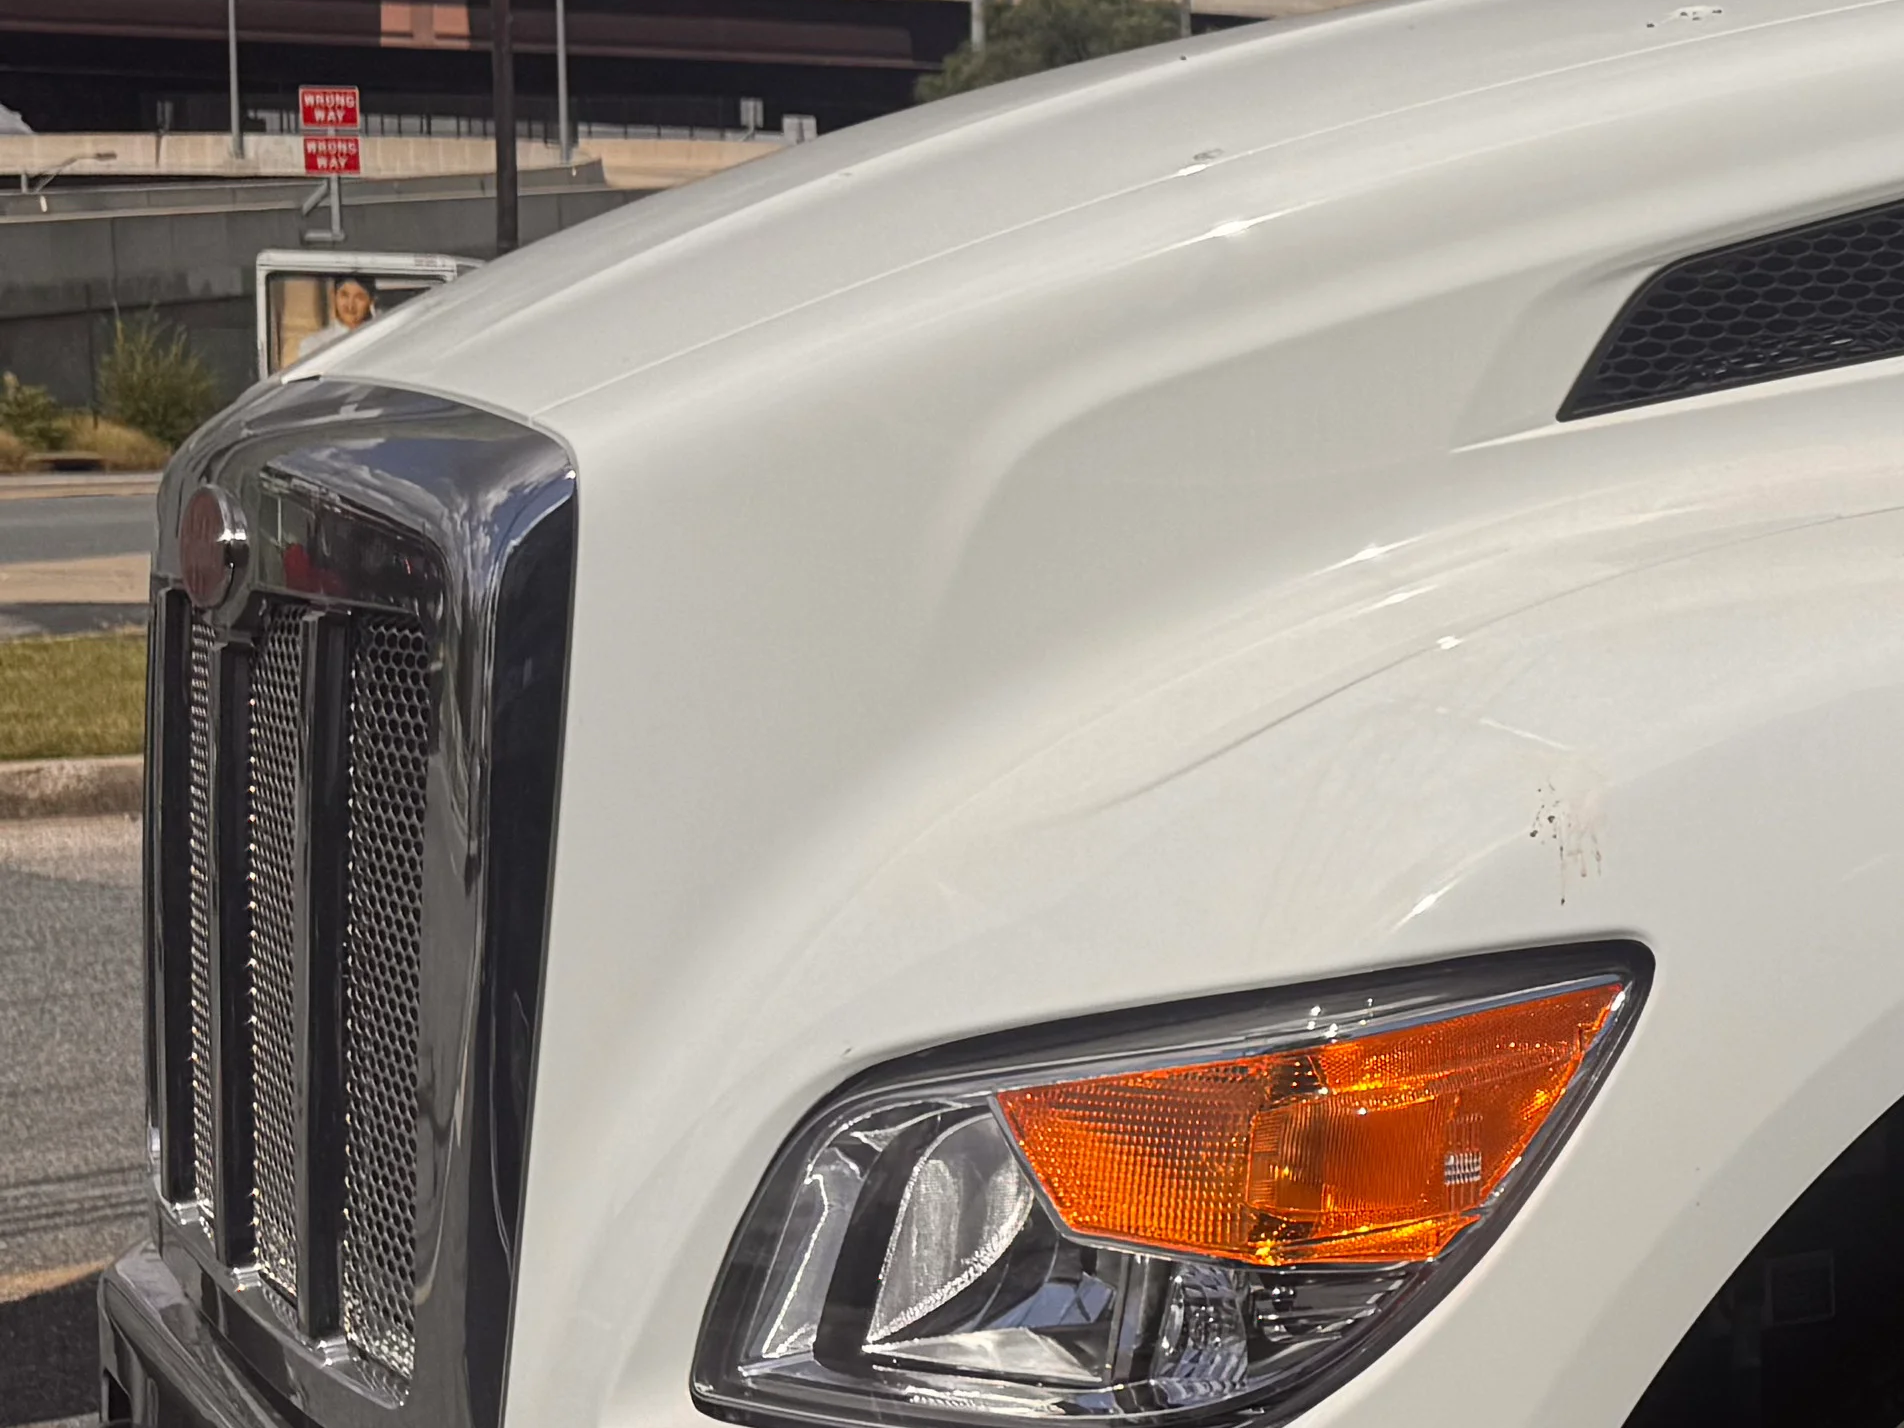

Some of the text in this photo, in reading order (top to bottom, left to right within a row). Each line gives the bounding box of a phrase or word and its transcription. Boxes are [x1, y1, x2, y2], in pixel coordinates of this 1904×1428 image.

[304, 92, 355, 108] WRONG
[314, 108, 346, 123] WAY
[306, 139, 357, 155] WRONG
[316, 155, 349, 170] WAY
